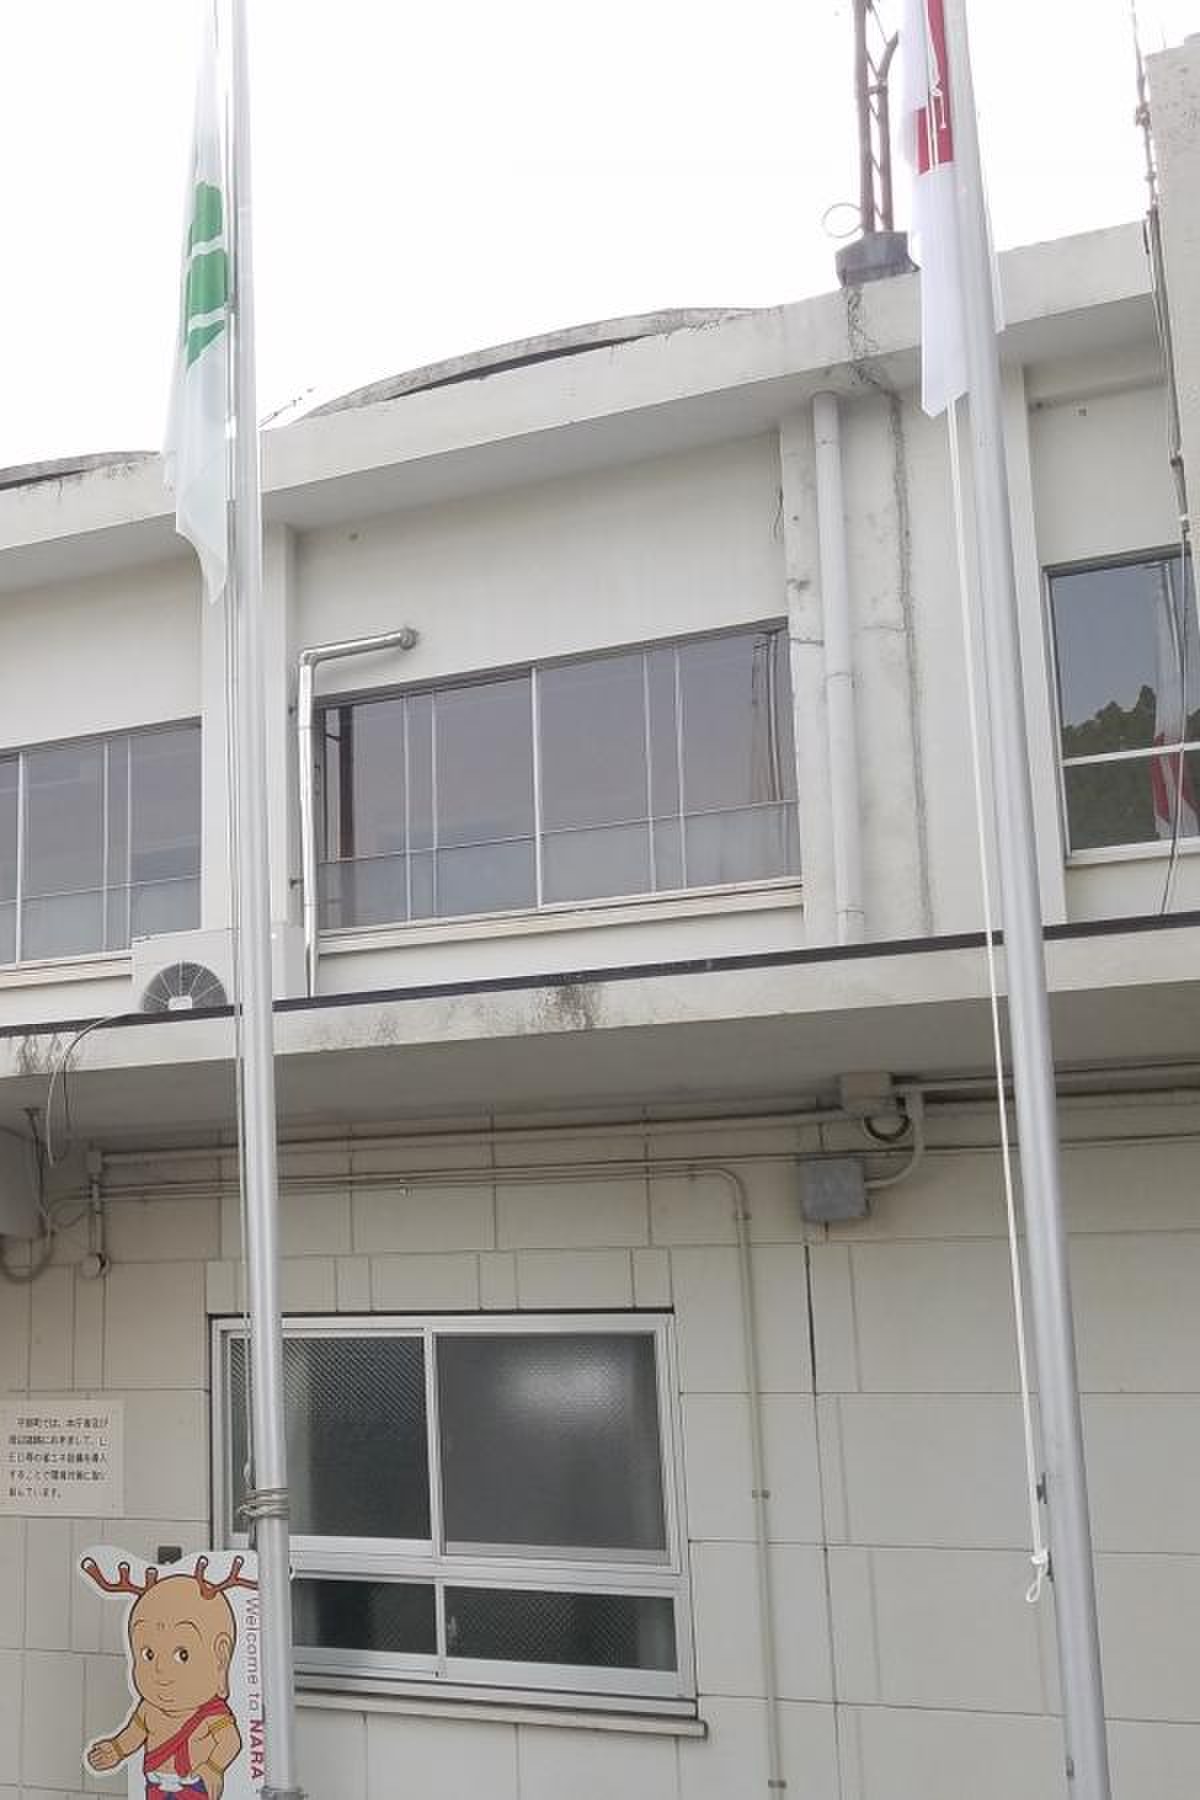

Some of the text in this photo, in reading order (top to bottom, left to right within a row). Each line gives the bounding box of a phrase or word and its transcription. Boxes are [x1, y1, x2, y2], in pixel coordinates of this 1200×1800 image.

[246, 1597, 265, 1780] Welcome to NARA
